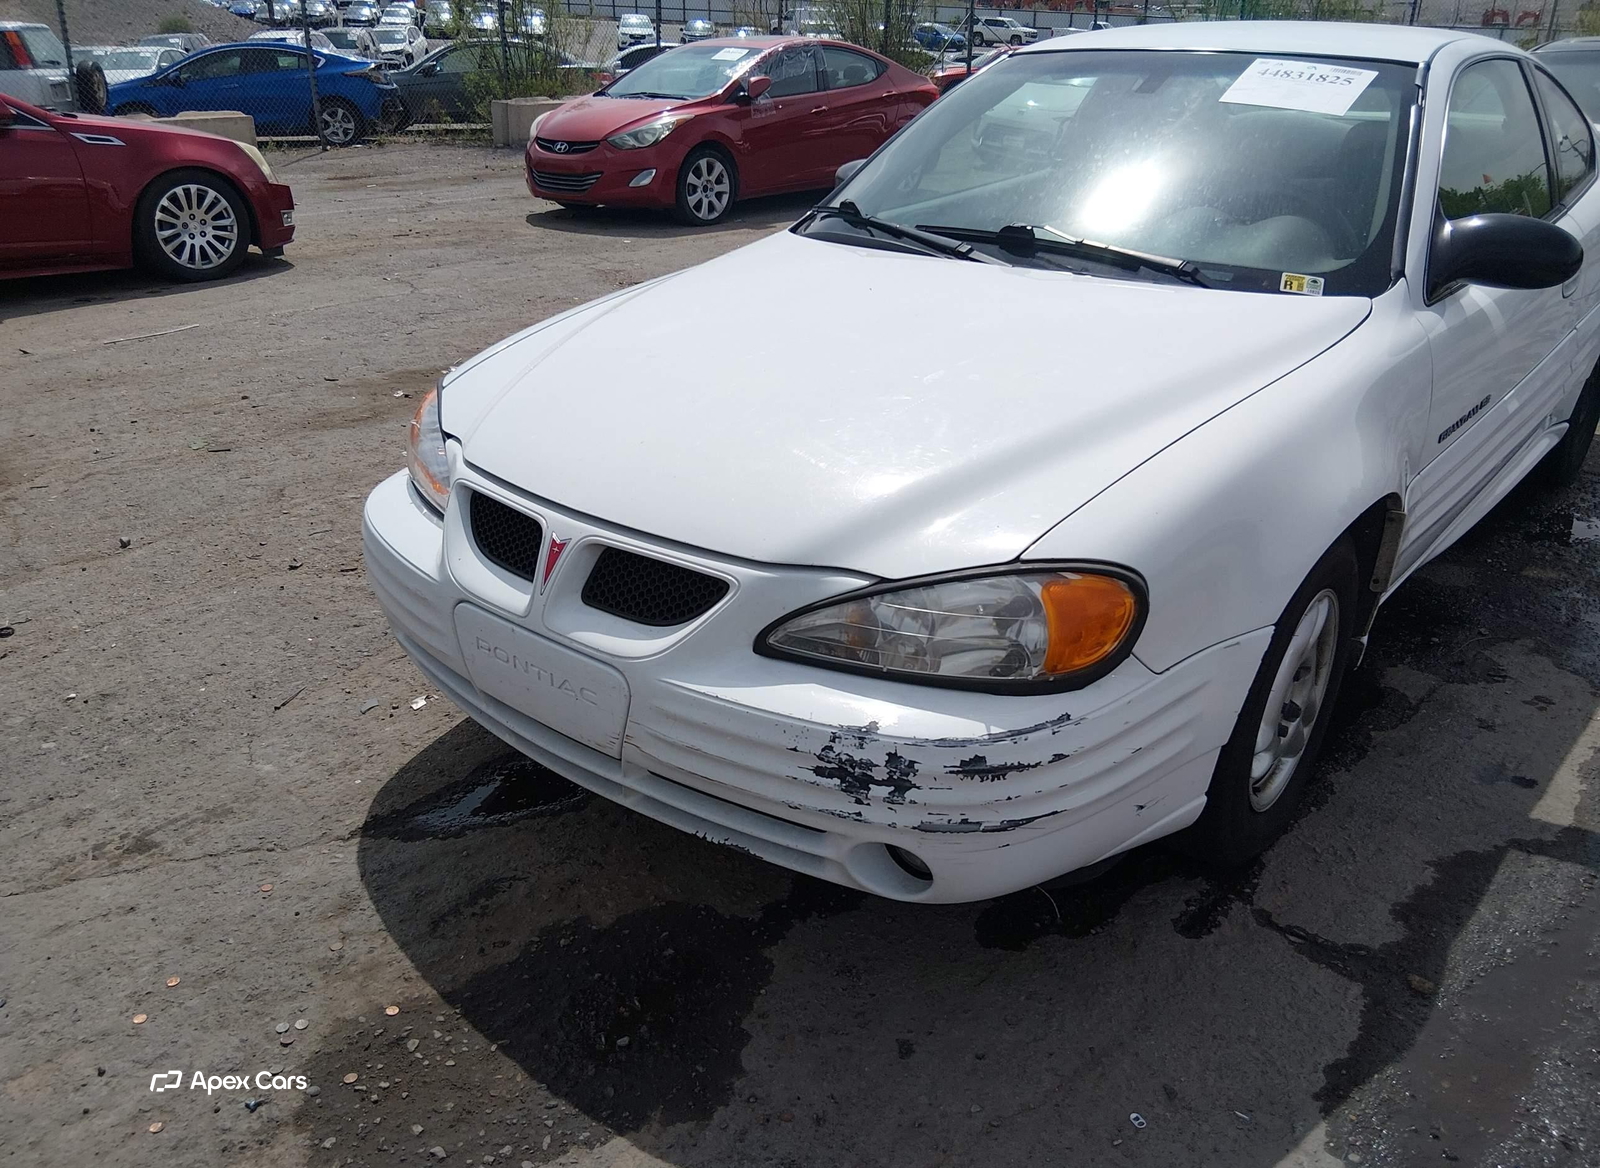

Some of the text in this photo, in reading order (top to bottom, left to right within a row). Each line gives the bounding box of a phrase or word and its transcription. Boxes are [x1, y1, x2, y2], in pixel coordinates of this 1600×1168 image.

[1257, 67, 1355, 86] 44831825
[1284, 280, 1293, 290] R
[475, 636, 598, 706] PONTIAC
